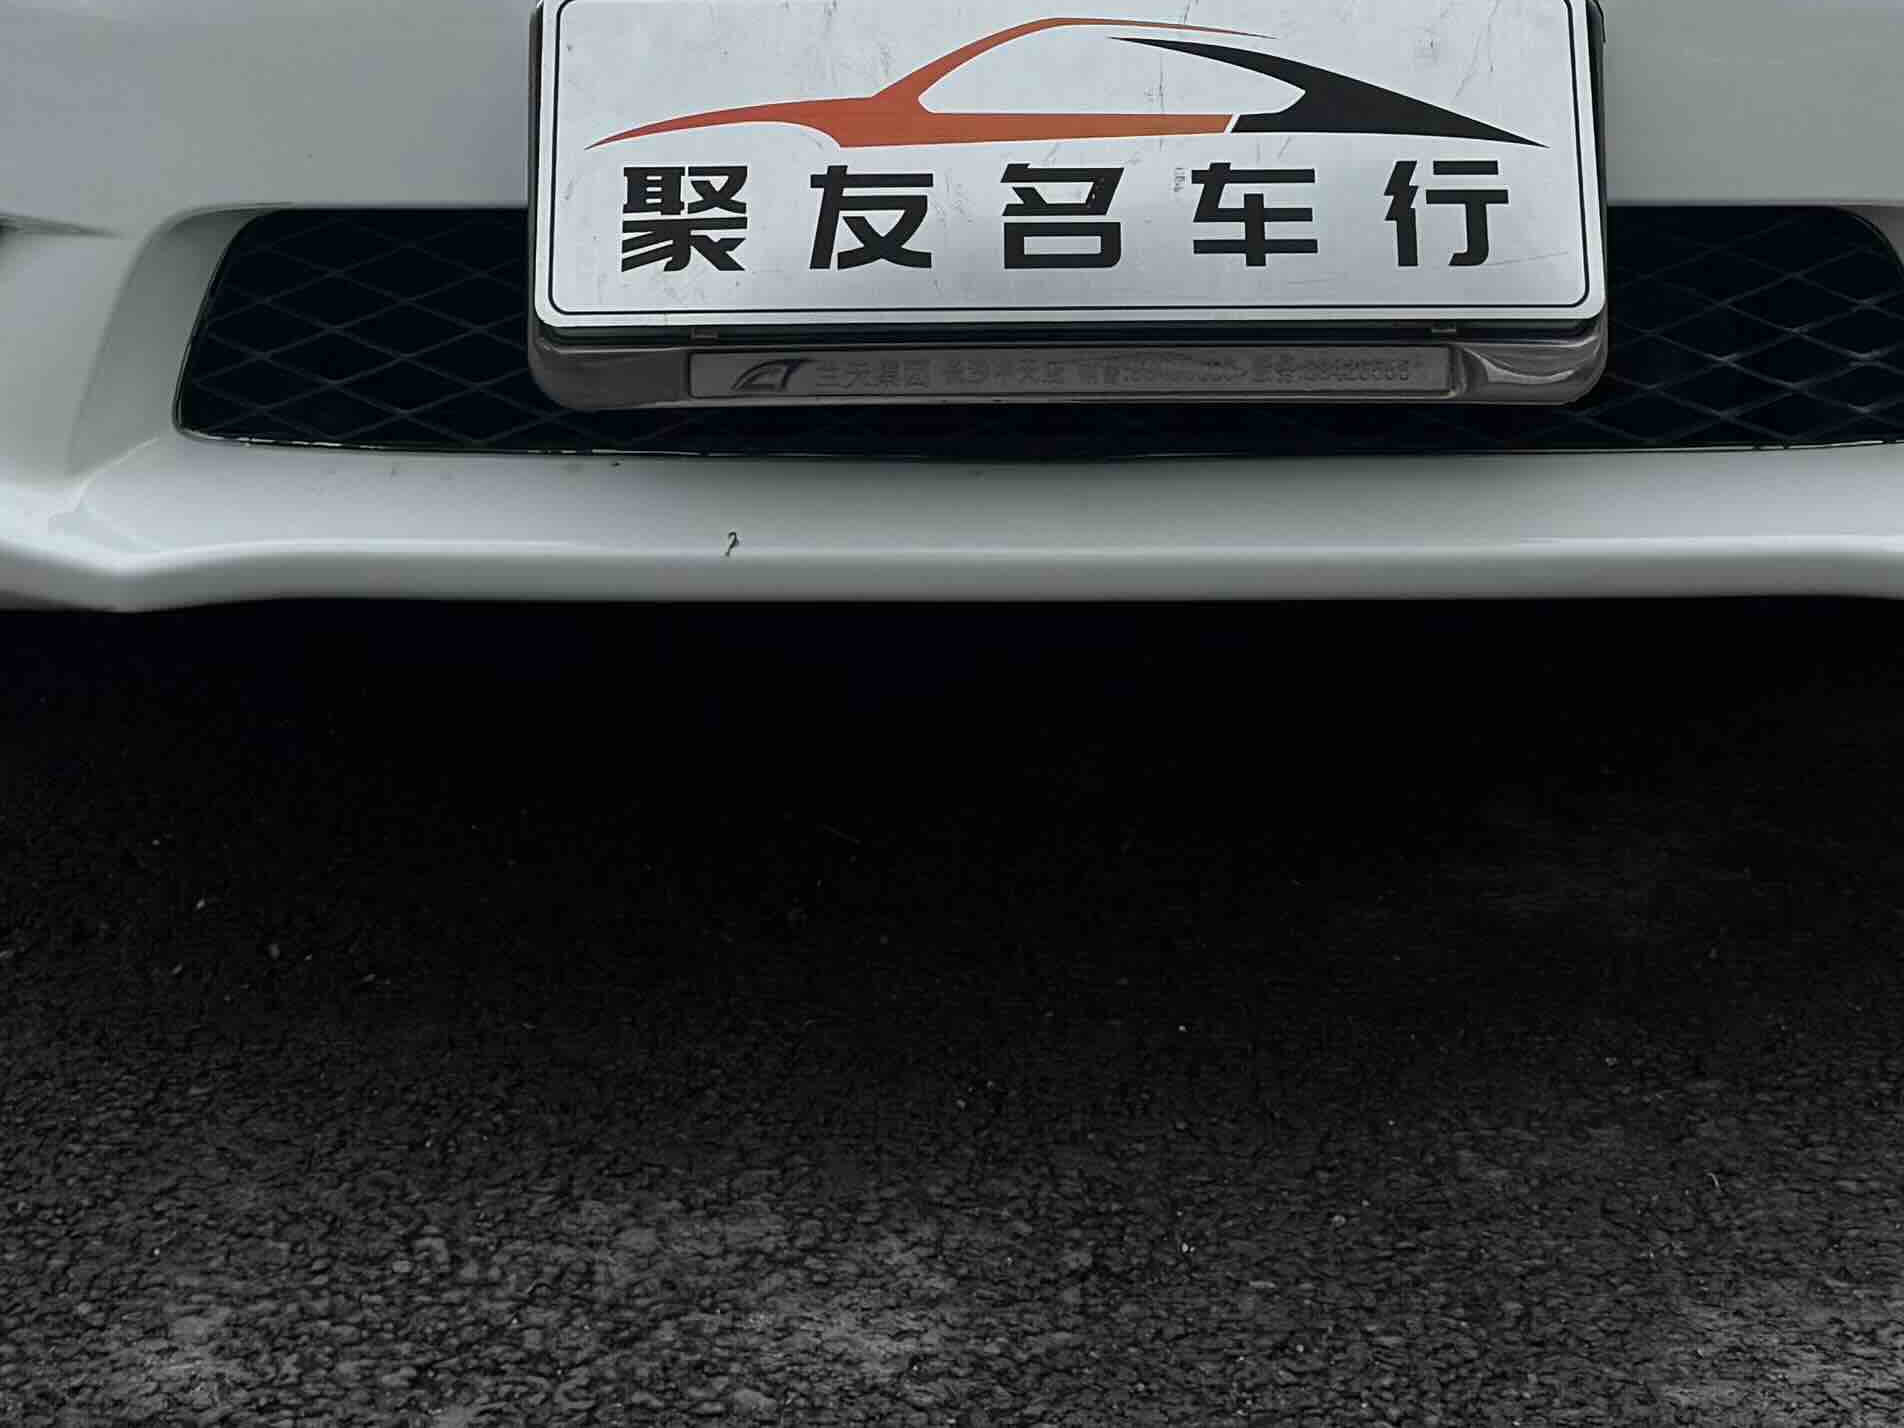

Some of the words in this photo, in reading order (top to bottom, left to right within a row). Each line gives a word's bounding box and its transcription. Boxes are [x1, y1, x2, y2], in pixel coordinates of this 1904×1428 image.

[620, 159, 1510, 273] 聚友名车行
